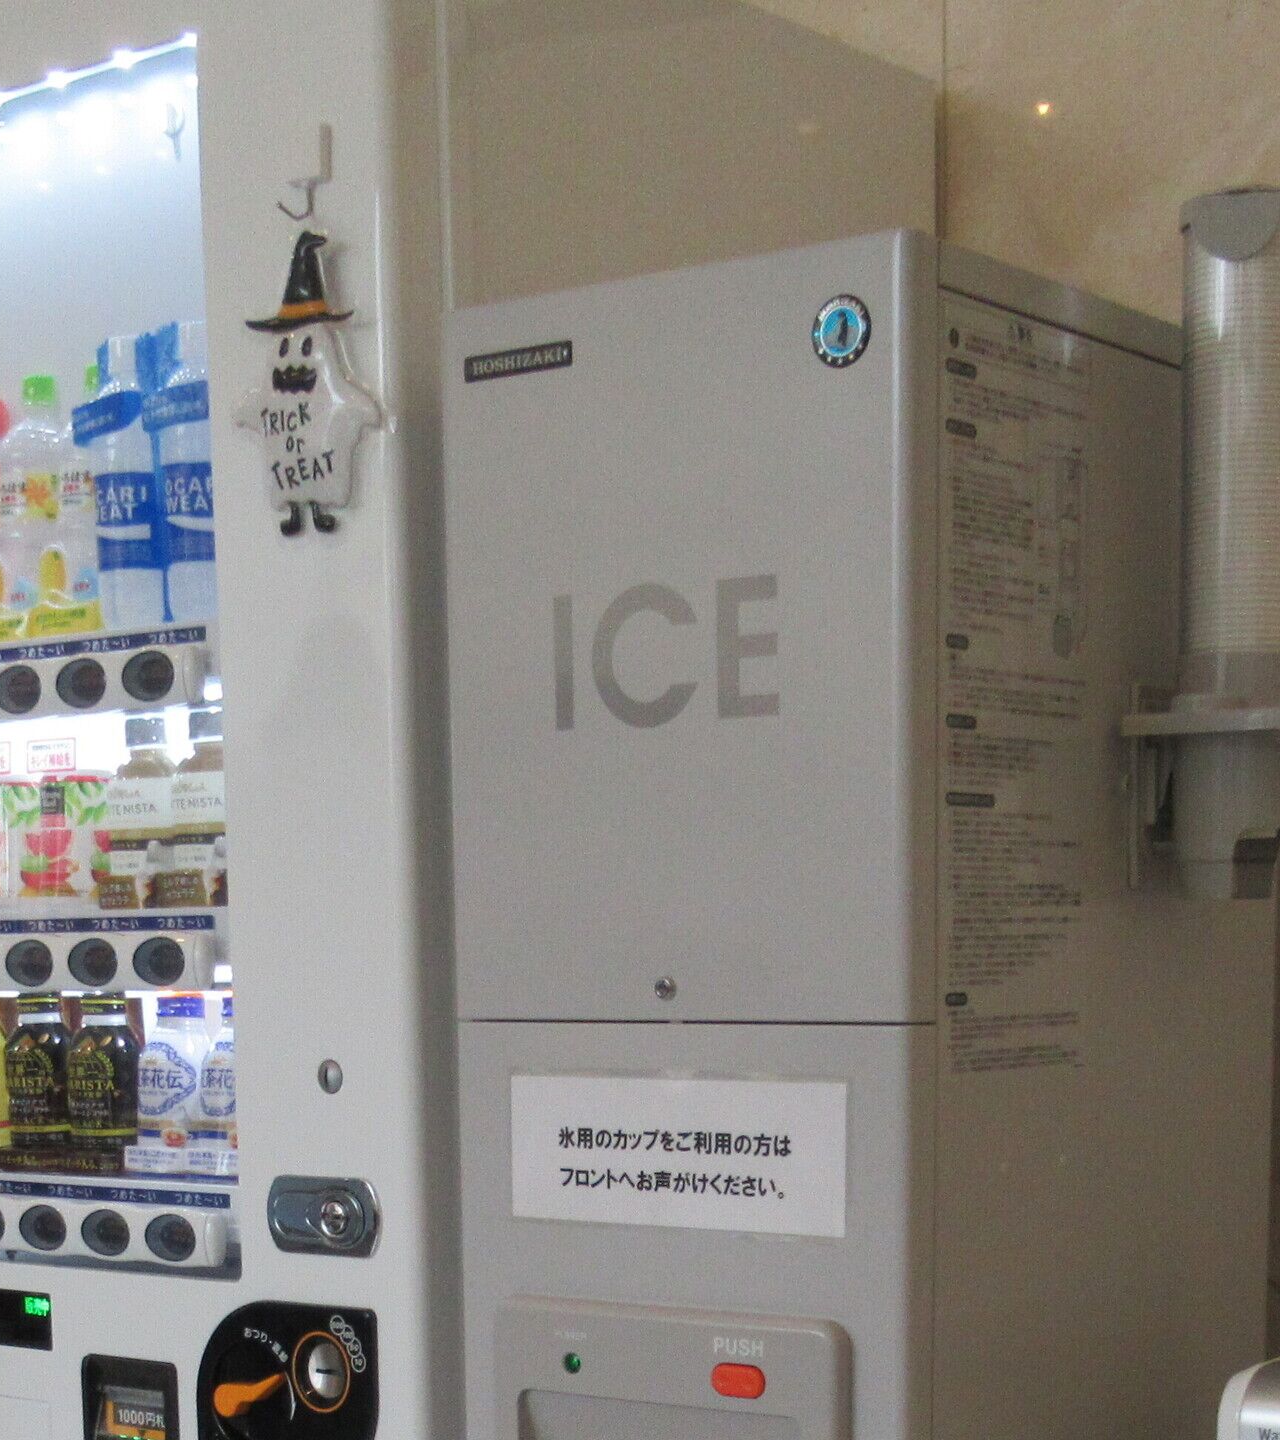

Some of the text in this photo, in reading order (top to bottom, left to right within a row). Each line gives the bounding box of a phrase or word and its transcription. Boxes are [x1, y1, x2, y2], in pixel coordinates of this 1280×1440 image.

[472, 346, 561, 376] HOSHIZAKI
[260, 403, 312, 437] TRICK
[272, 450, 335, 490] TREAT
[553, 573, 780, 732] ICE
[558, 1126, 792, 1157] 氷用のカップをご利用の方は
[559, 1167, 785, 1200] フロントへお声がけください。
[712, 1336, 764, 1357] PUSH
